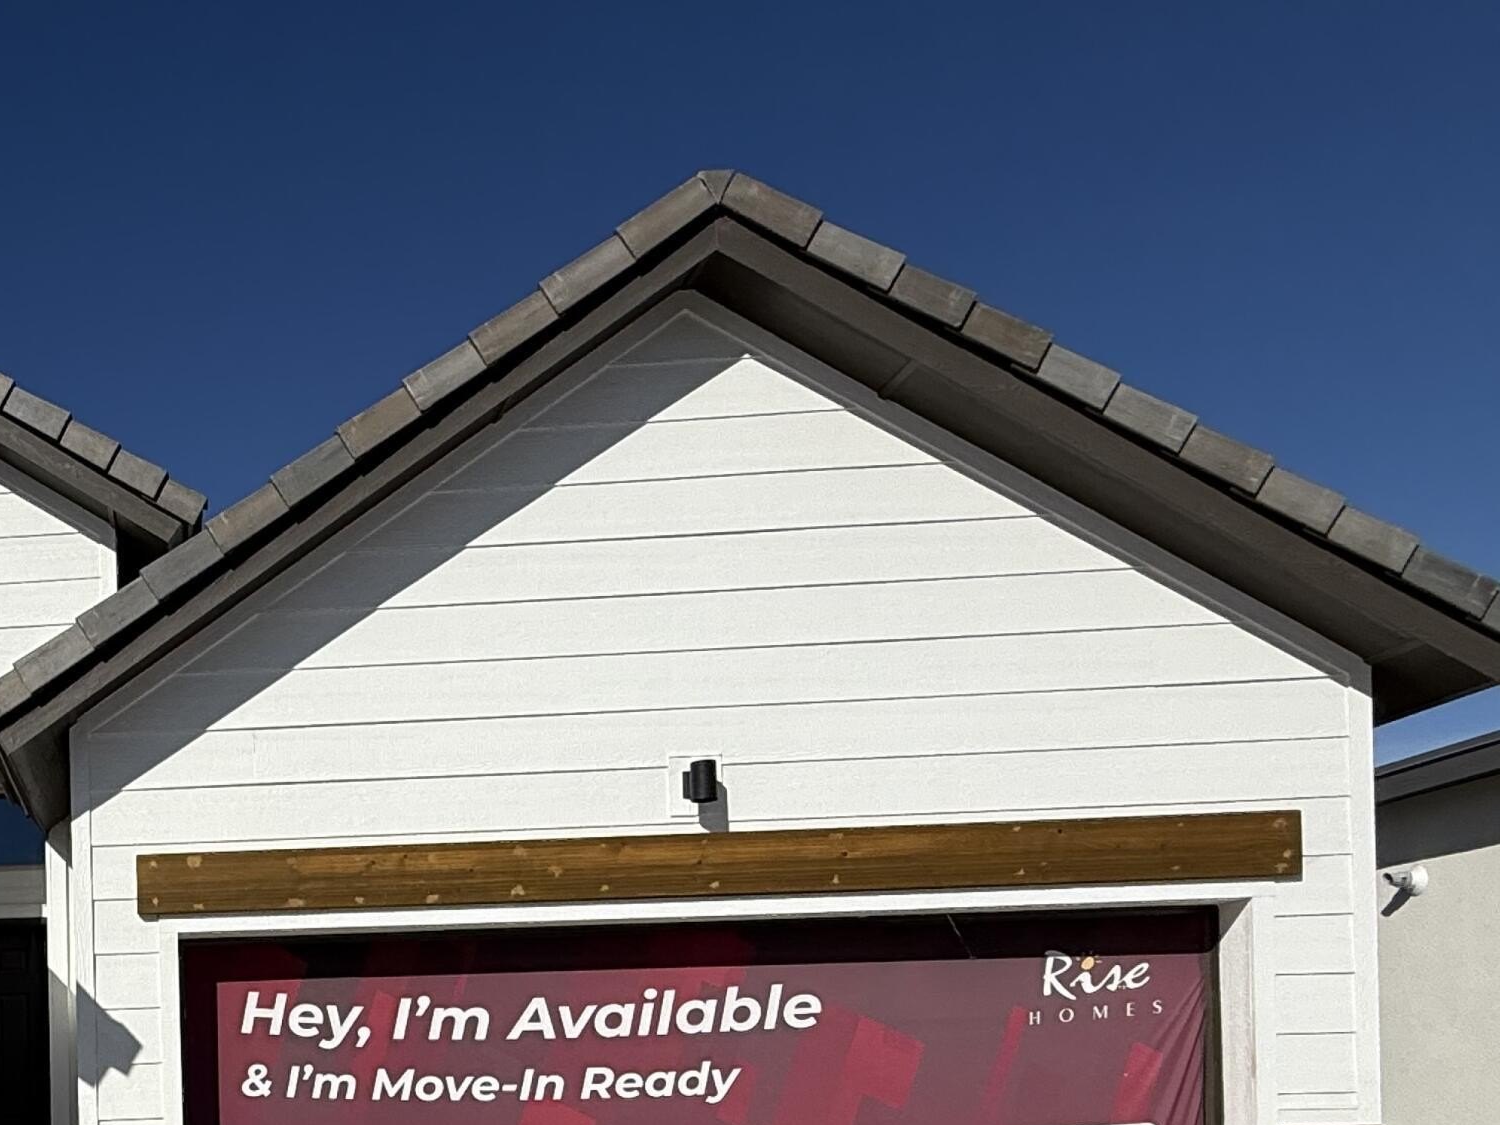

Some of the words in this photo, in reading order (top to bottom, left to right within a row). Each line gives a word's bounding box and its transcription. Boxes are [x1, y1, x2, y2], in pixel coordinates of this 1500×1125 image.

[1042, 950, 1150, 1000] Rise
[241, 991, 371, 1049] Hey,
[393, 996, 489, 1041] I'm
[506, 984, 822, 1041] Available
[1028, 999, 1163, 1025] HOMES
[241, 1063, 272, 1098] &
[286, 1064, 357, 1100] I'm
[372, 1067, 565, 1101] Move-In
[581, 1061, 742, 1104] Ready
